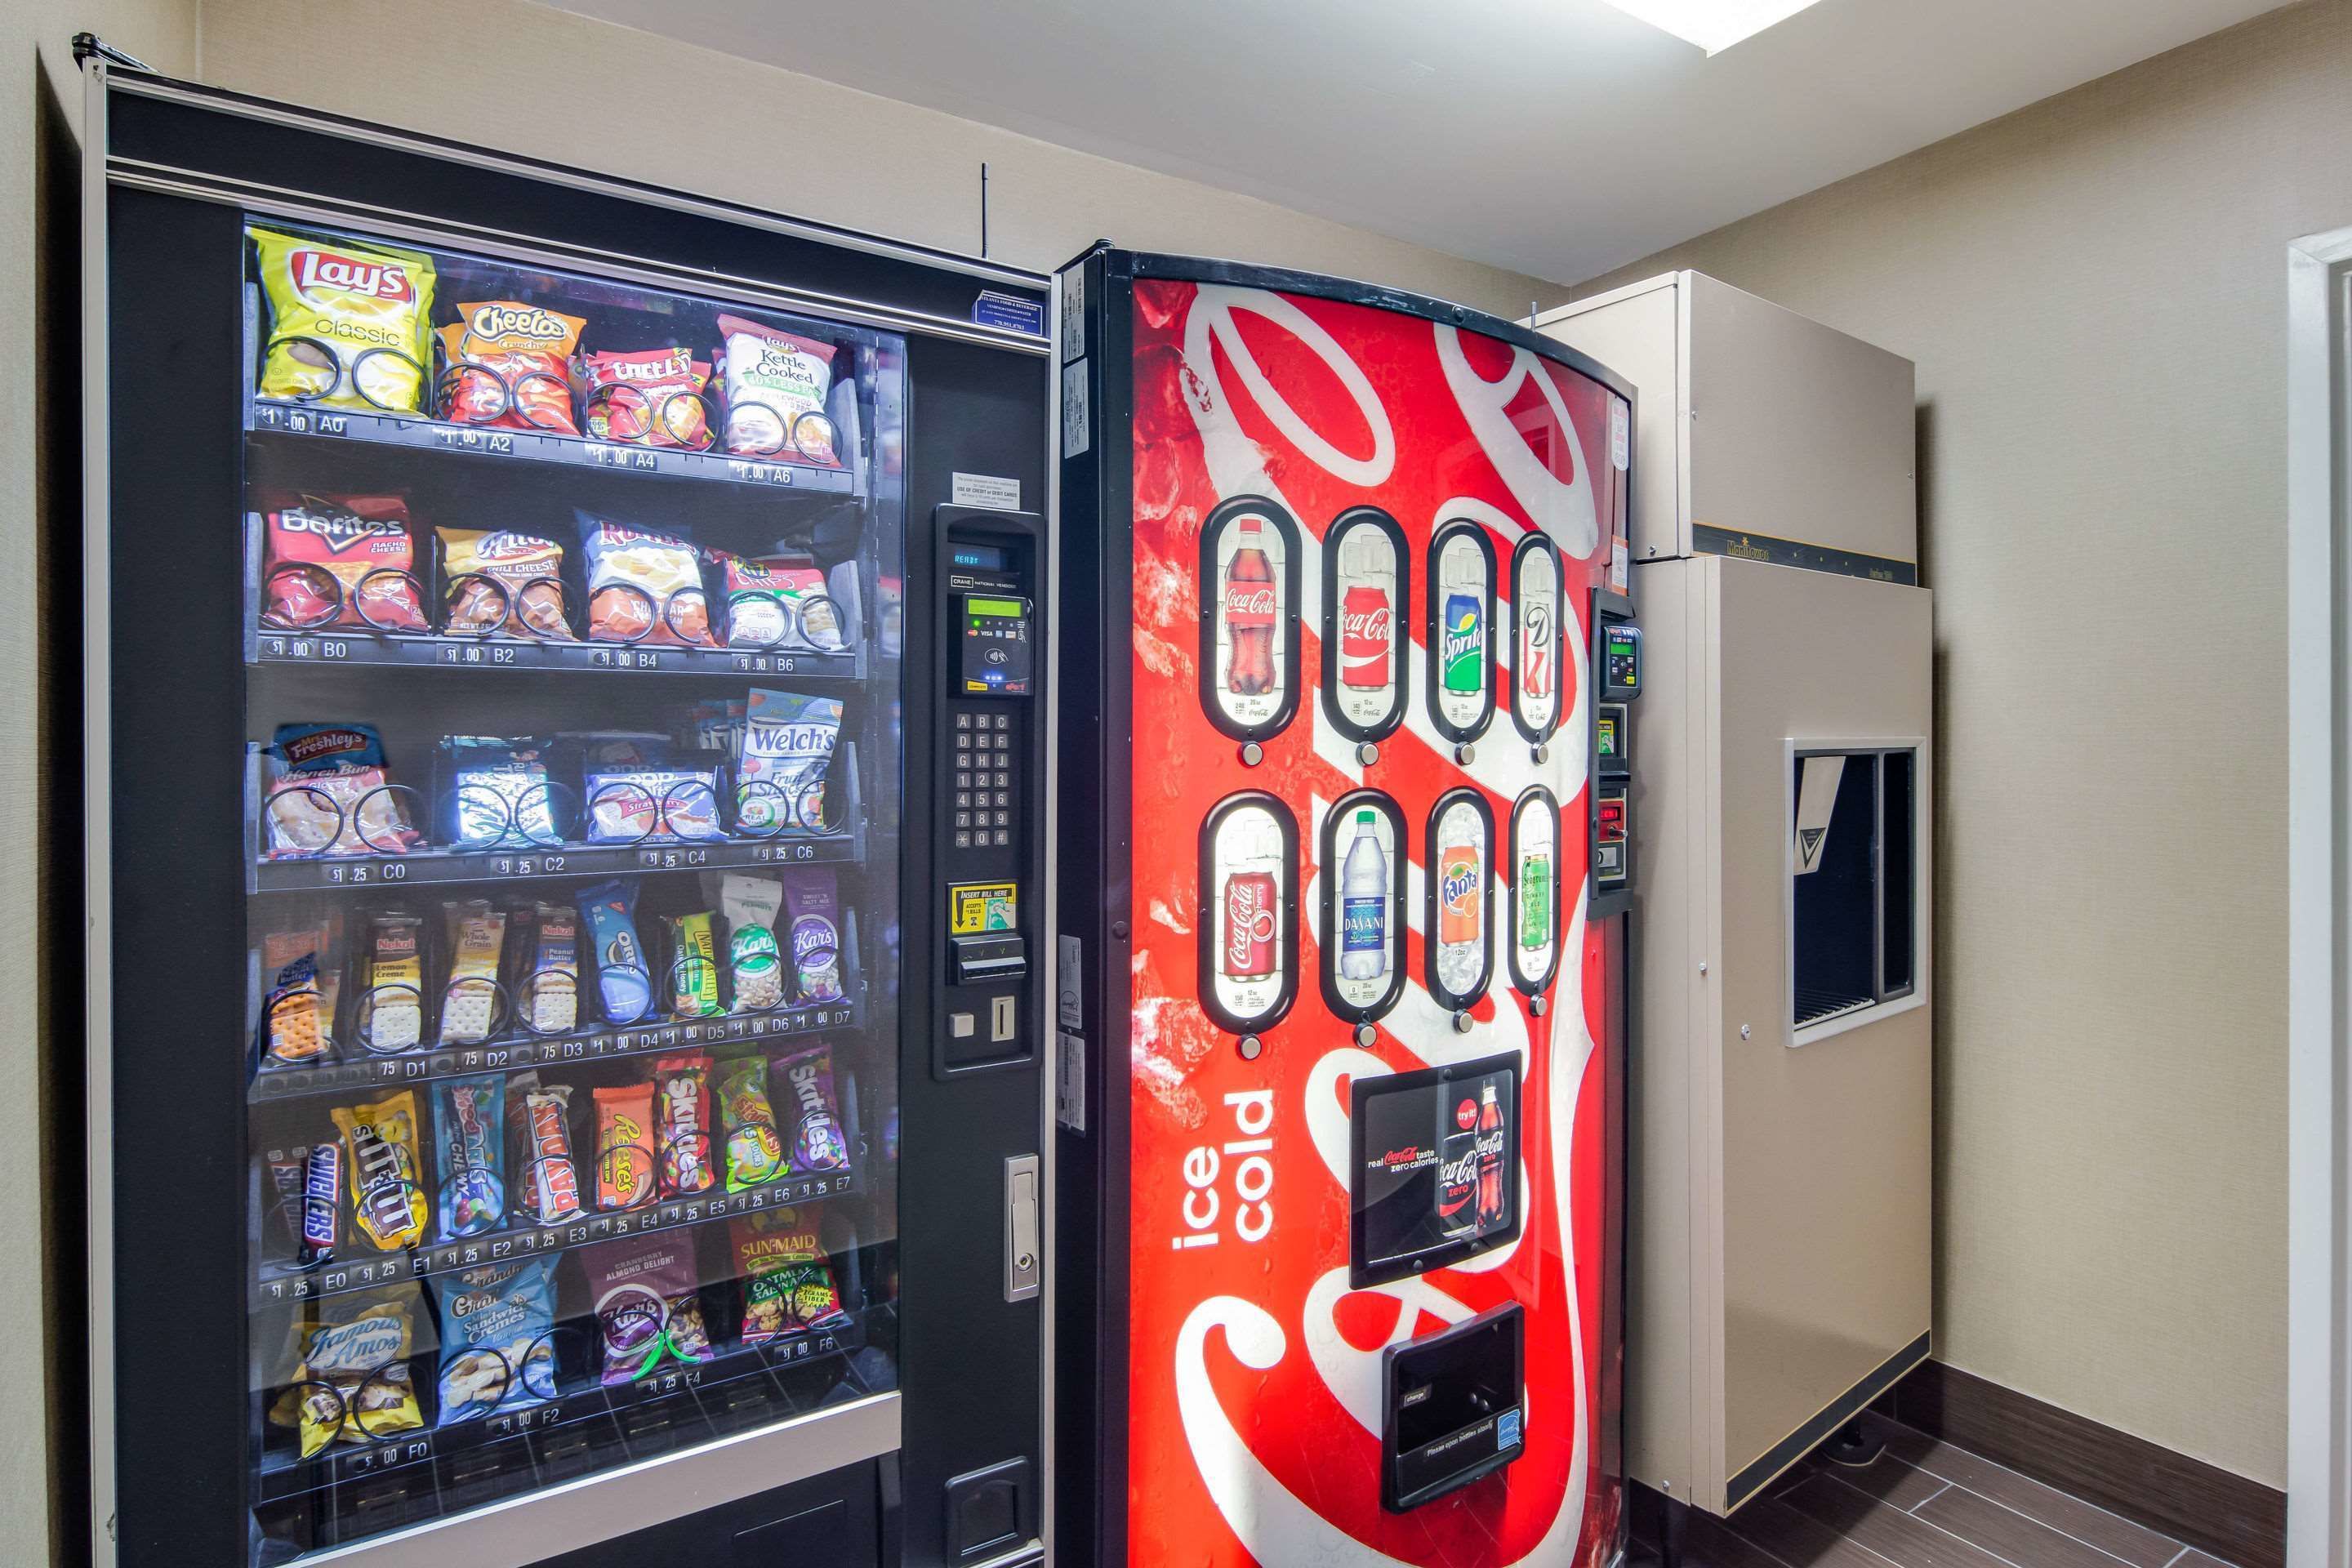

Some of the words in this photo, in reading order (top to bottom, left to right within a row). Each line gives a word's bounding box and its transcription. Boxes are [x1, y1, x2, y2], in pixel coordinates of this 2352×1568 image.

[301, 252, 405, 297] Lay's
[473, 305, 566, 340] Cheetos
[314, 318, 399, 347] Classic
[497, 339, 548, 350] Crunchy
[760, 349, 806, 370] Kettle
[755, 363, 813, 385] Cooked
[490, 436, 510, 451] A2
[636, 454, 655, 468] A4
[774, 470, 791, 483] A6
[282, 508, 405, 537] Doritos
[372, 541, 406, 550] NACHO
[515, 559, 555, 572] CHEESE
[953, 578, 972, 586] CRANE
[1227, 588, 1276, 615] Coca-Cola
[1445, 628, 1482, 662] Sprite
[494, 648, 514, 663] B2
[639, 653, 657, 667] B4
[777, 659, 794, 672] B6
[960, 717, 967, 727] A
[979, 717, 986, 727] B
[998, 718, 1004, 728] C
[291, 733, 363, 759] Freshley's
[752, 726, 836, 753] Welch's
[960, 737, 967, 746] D
[979, 737, 986, 746] E
[998, 737, 1004, 746] F
[960, 755, 967, 766] G
[979, 756, 986, 766] H
[998, 756, 1004, 766] J
[285, 767, 336, 782] Honey
[338, 764, 370, 775] Bun
[770, 770, 804, 786] Fruit
[960, 776, 965, 786] 1
[979, 776, 986, 786] 2
[998, 775, 1004, 785] 3
[959, 795, 965, 804] 4
[979, 795, 986, 804] 5
[997, 794, 1004, 804] 6
[960, 814, 966, 824] 7
[979, 813, 985, 824] 8
[997, 813, 1004, 823] 9
[688, 850, 706, 864] C4
[797, 845, 813, 859] C6
[545, 858, 564, 871] C2
[960, 890, 980, 899] INSERT
[1254, 884, 1265, 915] cherry
[1227, 879, 1254, 969] Coca-Cola
[1344, 915, 1384, 933] DASANI
[461, 932, 490, 941] Whole
[465, 939, 492, 949] Grain
[795, 929, 833, 952] Kar's
[376, 964, 407, 972] Lemon
[376, 970, 406, 978] Creme
[835, 1010, 850, 1024] D7
[707, 1025, 725, 1040] D5
[773, 1018, 789, 1032] D6
[640, 1034, 659, 1048] D4
[564, 1042, 583, 1058] D3
[487, 1051, 507, 1067] D2
[407, 1061, 425, 1076] D1
[789, 1063, 831, 1163] Skittles
[1458, 1111, 1468, 1121] try
[613, 1114, 642, 1193] Reese's
[1368, 1157, 1383, 1169] real
[1384, 1147, 1418, 1165] Coca-Cola
[1416, 1150, 1435, 1160] taste
[1483, 1153, 1496, 1163] zero
[1223, 1089, 1274, 1242] cold
[1391, 1162, 1409, 1173] zero
[1410, 1156, 1439, 1169] calories
[836, 1177, 850, 1191] E7
[1448, 1183, 1469, 1198] zero
[775, 1187, 790, 1201] E6
[1172, 1147, 1220, 1250] ice
[710, 1200, 726, 1216] E5
[641, 1214, 658, 1228] E4
[569, 1227, 587, 1242] E3
[492, 1241, 511, 1257] E2
[413, 1256, 430, 1272] E1
[605, 1264, 641, 1281] ALMOND
[644, 1254, 675, 1270] DELIGHT
[614, 1250, 663, 1271] CRANBERRY
[309, 1316, 402, 1356] Famous
[468, 1312, 525, 1345] Cremes
[330, 1334, 401, 1367] Amos
[819, 1336, 833, 1352] F6
[686, 1371, 701, 1387] F4
[542, 1409, 559, 1423] F2
[1428, 1443, 1445, 1457] Please
[1446, 1439, 1459, 1451] open
[1459, 1430, 1477, 1443] bottles
[1477, 1419, 1493, 1434] slowly
